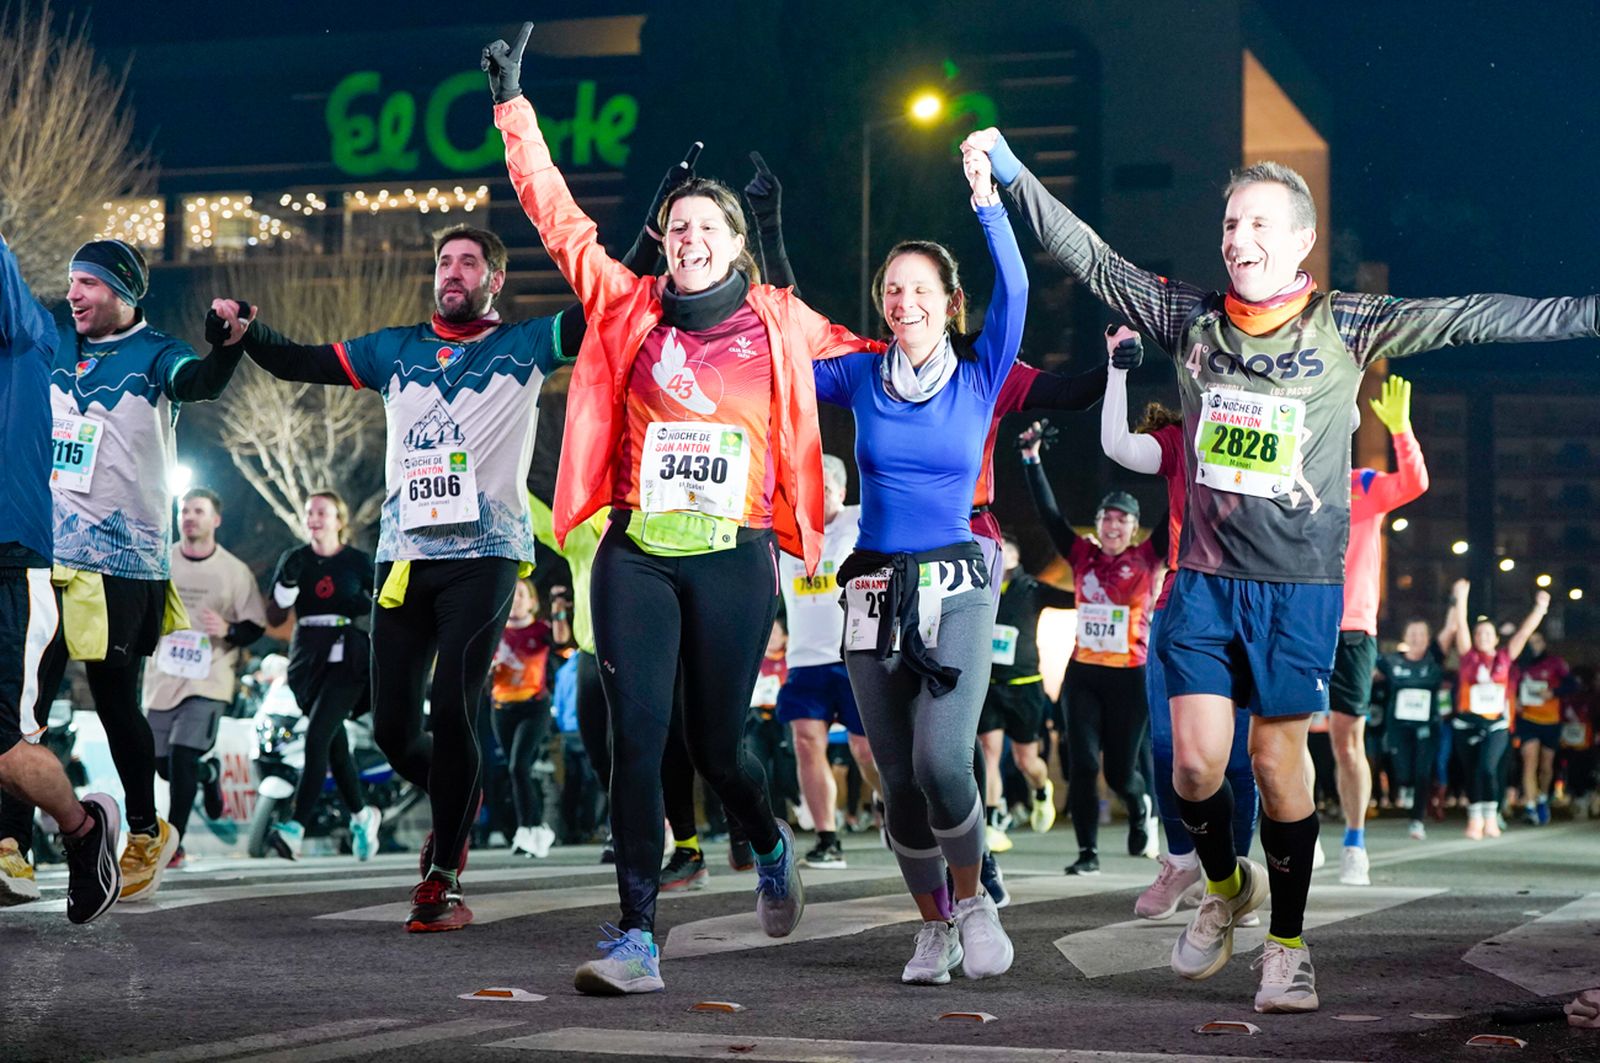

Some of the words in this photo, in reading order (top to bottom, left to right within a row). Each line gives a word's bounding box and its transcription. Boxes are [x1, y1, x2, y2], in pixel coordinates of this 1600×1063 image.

[325, 71, 418, 175] El
[424, 70, 639, 171] Crte
[667, 374, 694, 400] 43
[1222, 401, 1251, 414] NOCHE
[1251, 404, 1263, 416] DE
[1210, 411, 1228, 424] SAN
[668, 431, 698, 442] NOCHE
[699, 433, 712, 442] DE
[1211, 424, 1279, 463] 2828
[655, 442, 675, 453] SAN
[433, 457, 442, 465] DE
[659, 453, 728, 485] 3430
[409, 474, 461, 502] 6306
[855, 579, 870, 591] SAN
[1085, 622, 1115, 636] 6374
[170, 646, 203, 664] 4495
[223, 753, 249, 784] AN
